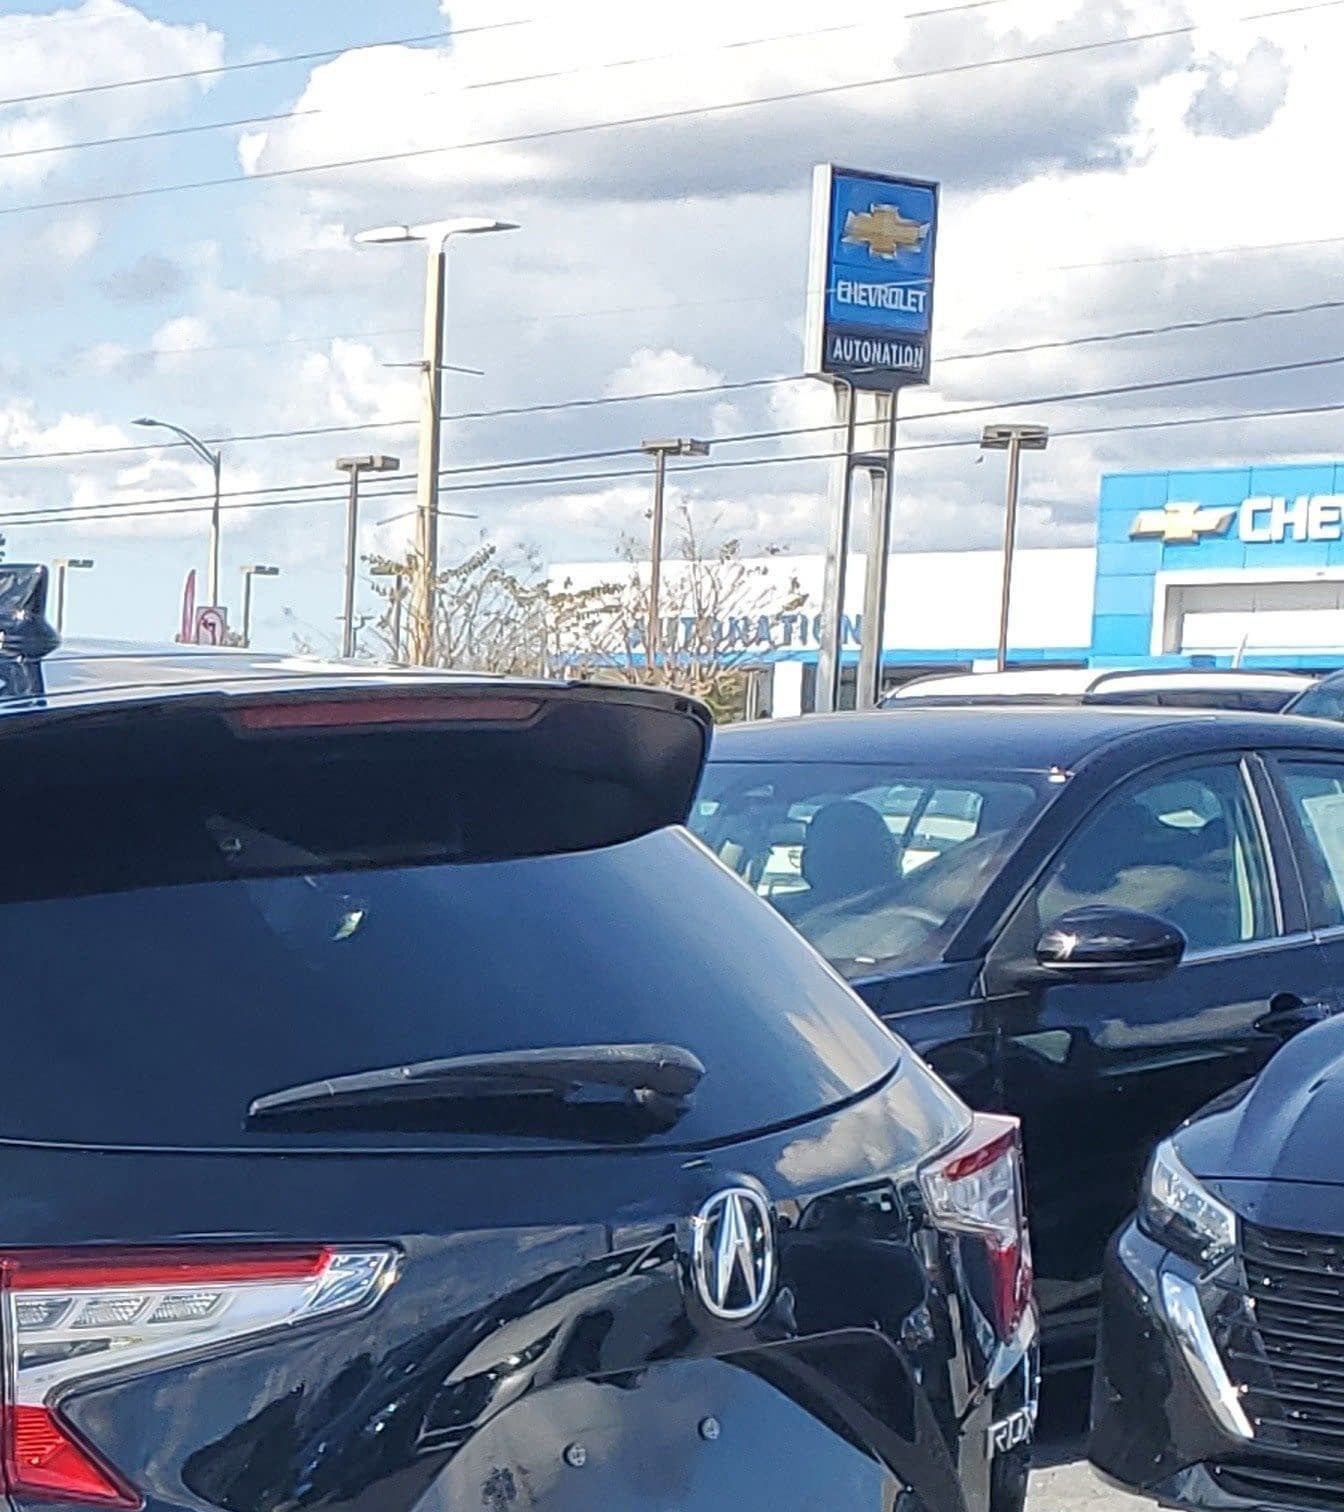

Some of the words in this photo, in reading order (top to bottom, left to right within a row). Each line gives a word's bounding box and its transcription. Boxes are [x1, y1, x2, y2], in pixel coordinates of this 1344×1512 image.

[837, 280, 926, 313] CHEVROLET
[833, 337, 923, 368] AUTONATION
[1239, 495, 1344, 544] CHE
[987, 1401, 1038, 1459] RDX
